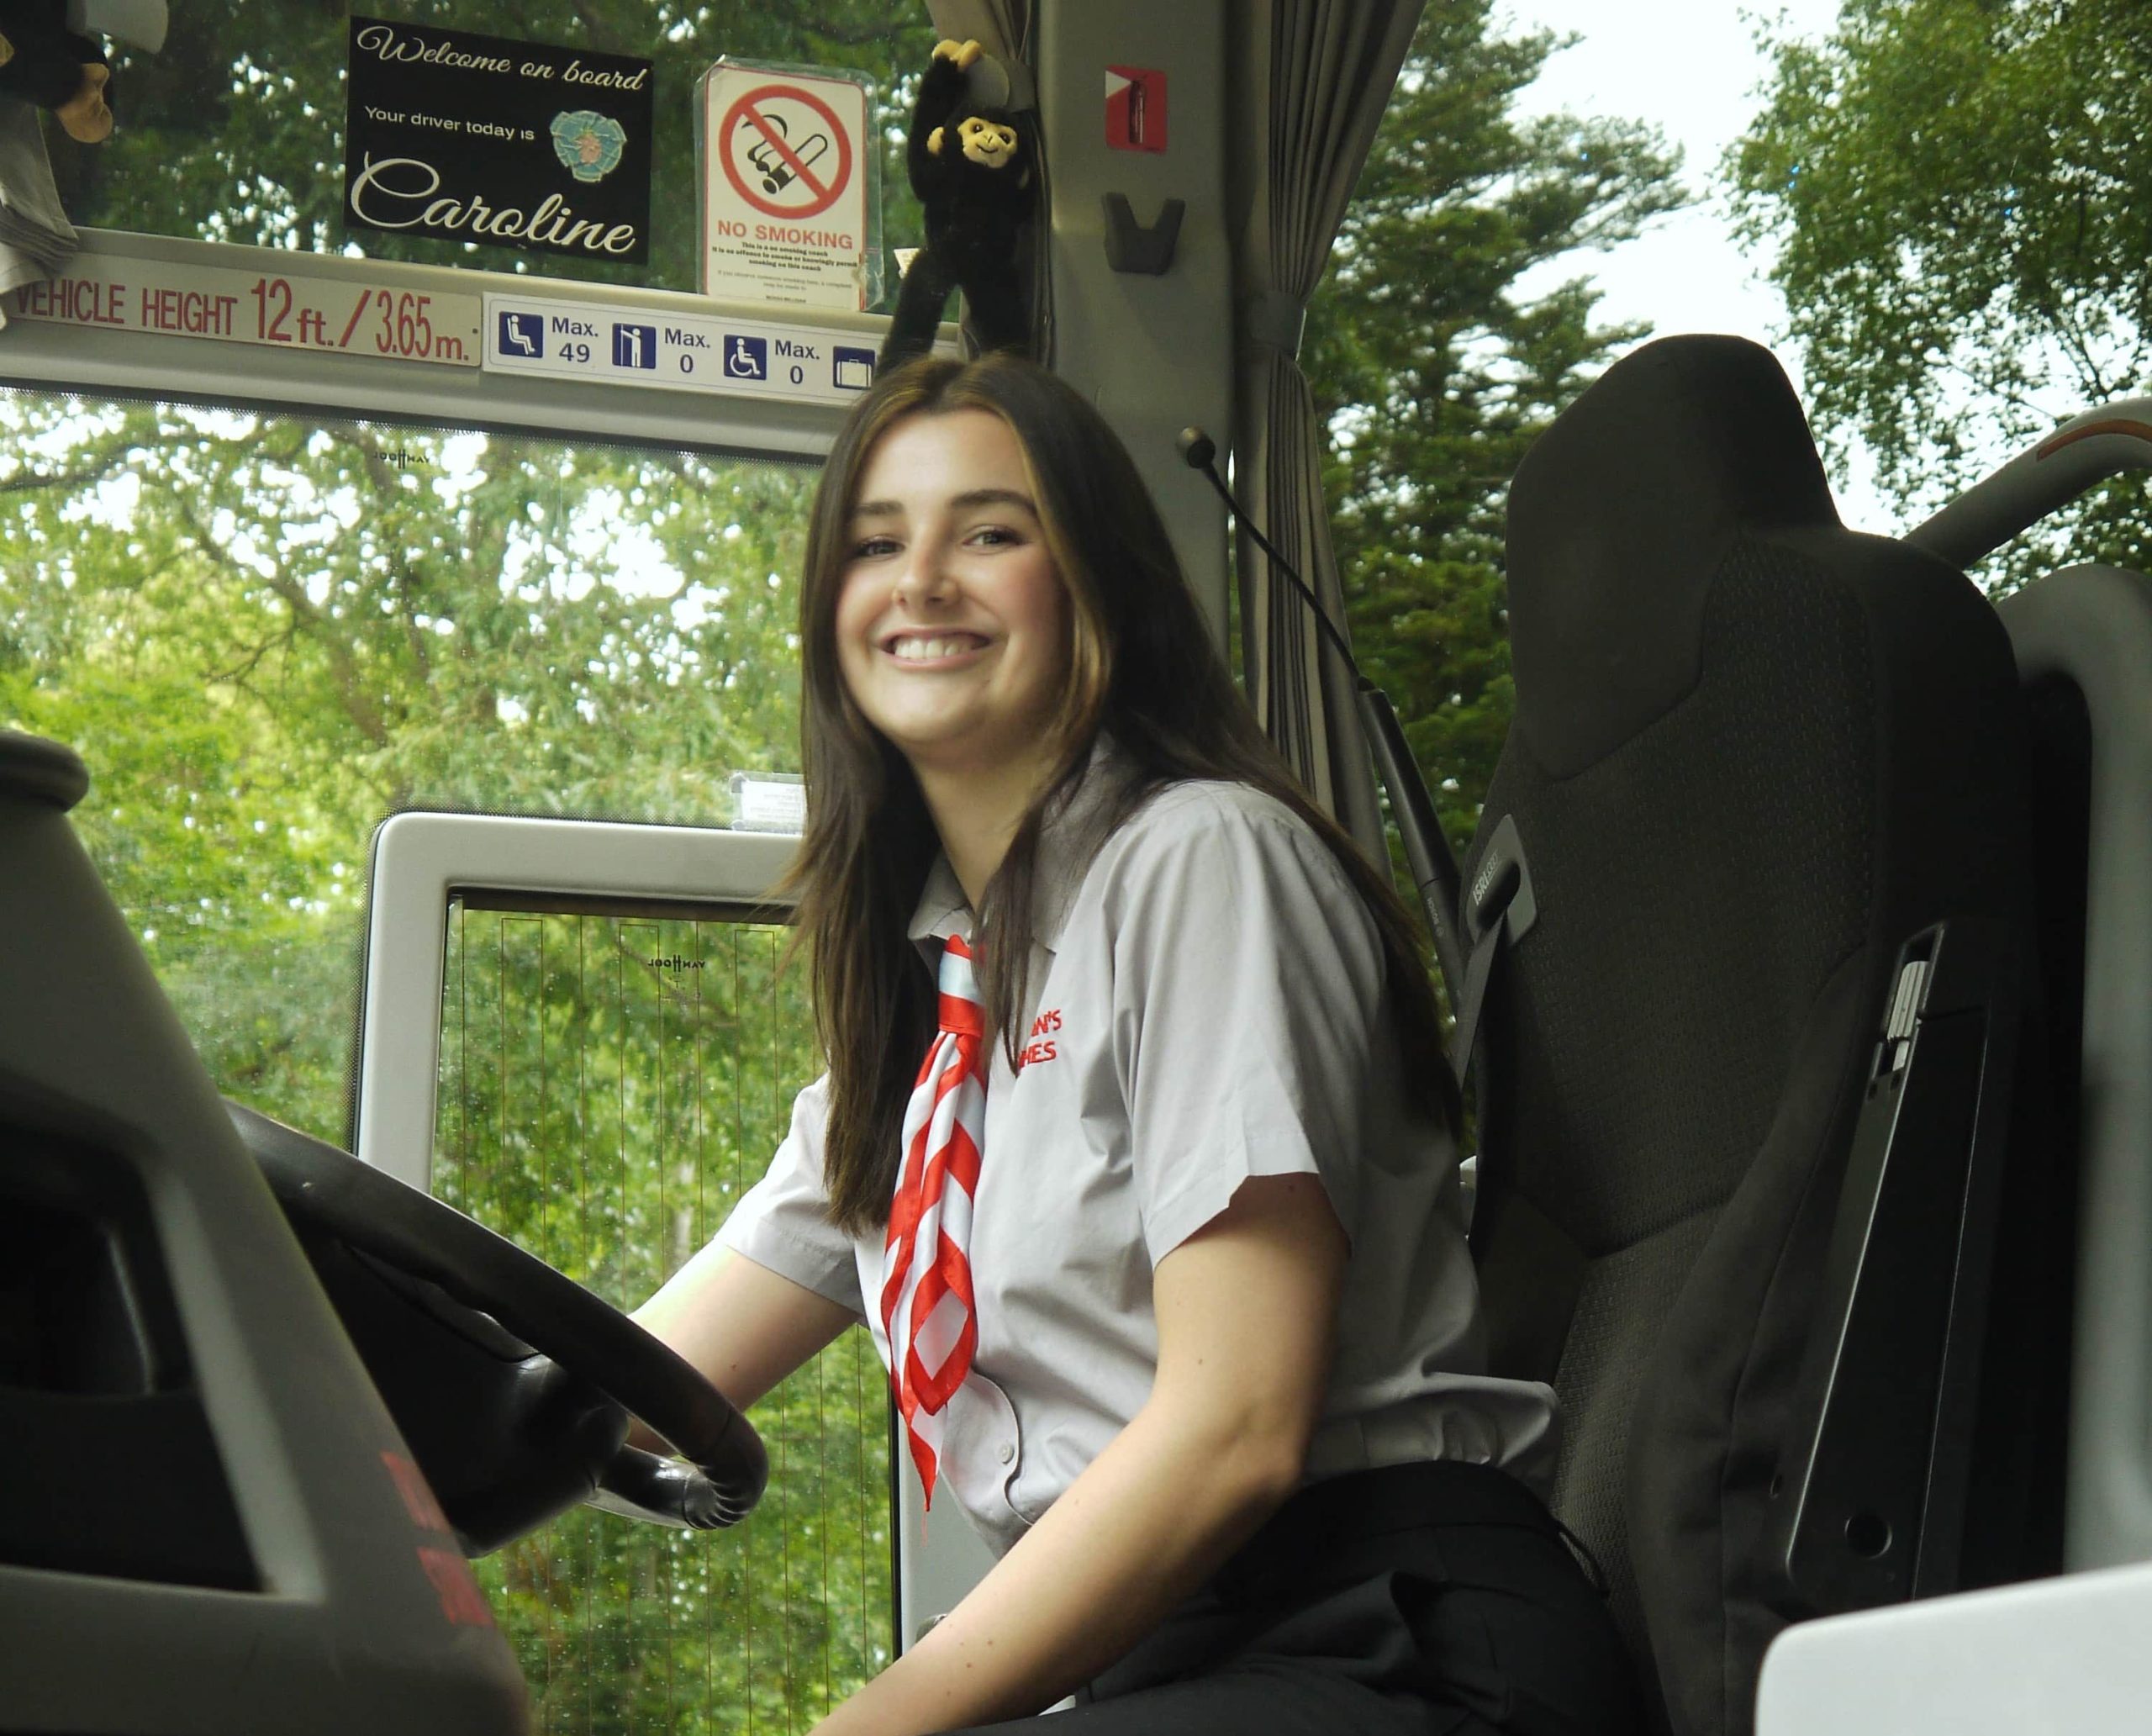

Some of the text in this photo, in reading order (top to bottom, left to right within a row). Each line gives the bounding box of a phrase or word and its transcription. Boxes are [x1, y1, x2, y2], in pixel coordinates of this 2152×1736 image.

[357, 26, 647, 91] Welcome on board
[365, 106, 535, 140] Your driver today is
[351, 150, 636, 253] Caroline
[718, 220, 852, 250] NO SMOKING
[779, 246, 806, 256] smoking
[17, 279, 125, 325] VEHICLE
[142, 288, 237, 335] HEIGHT
[551, 316, 599, 338] Max.
[665, 328, 711, 349] Max.
[559, 343, 590, 363] 49
[774, 340, 820, 360] Max.
[680, 355, 694, 373] 0
[789, 366, 804, 384] 0
